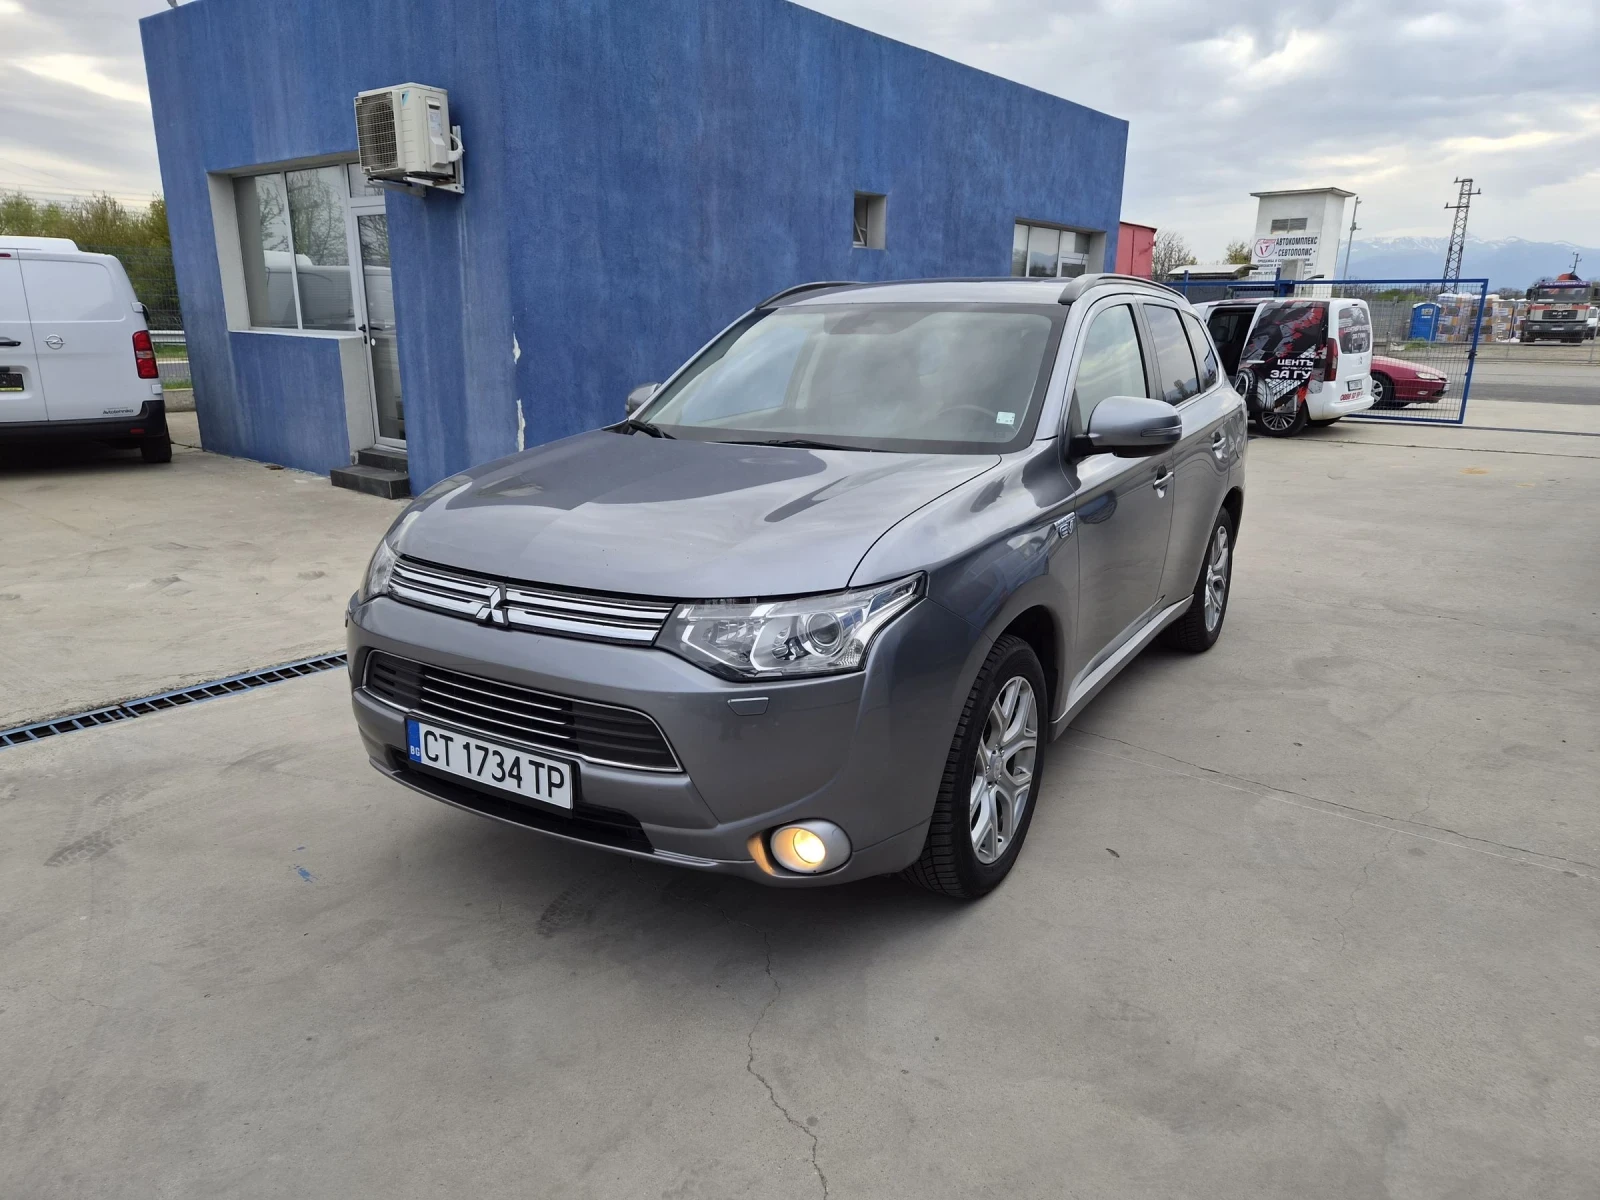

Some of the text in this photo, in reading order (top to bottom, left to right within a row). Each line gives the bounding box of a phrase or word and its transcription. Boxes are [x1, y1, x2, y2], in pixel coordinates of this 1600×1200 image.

[1276, 236, 1318, 246] АВТОКОМПЛЕКС
[1277, 358, 1314, 366] ЦЕНТЪ
[1270, 369, 1311, 379] ЗА ГУ
[410, 745, 420, 756] BG
[423, 730, 565, 798] CT 1734 TP
